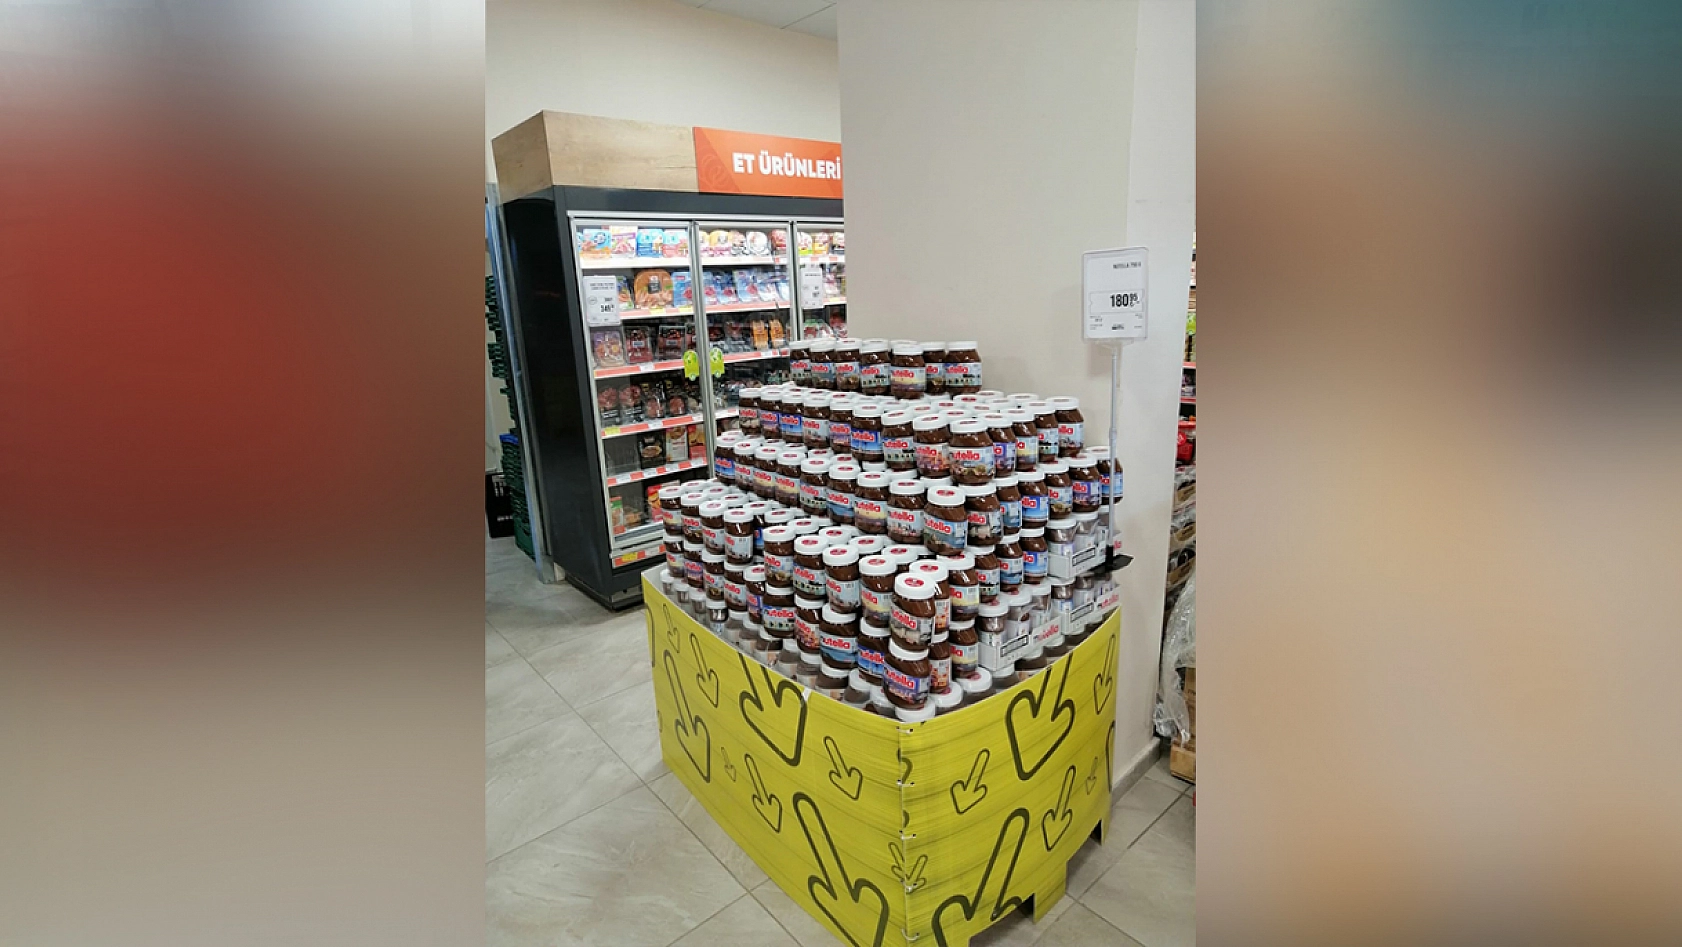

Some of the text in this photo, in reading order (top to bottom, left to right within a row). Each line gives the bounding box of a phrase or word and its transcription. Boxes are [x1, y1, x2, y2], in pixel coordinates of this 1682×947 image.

[732, 152, 841, 179] ET ÜRÜNLERİ
[1109, 293, 1129, 308] 180
